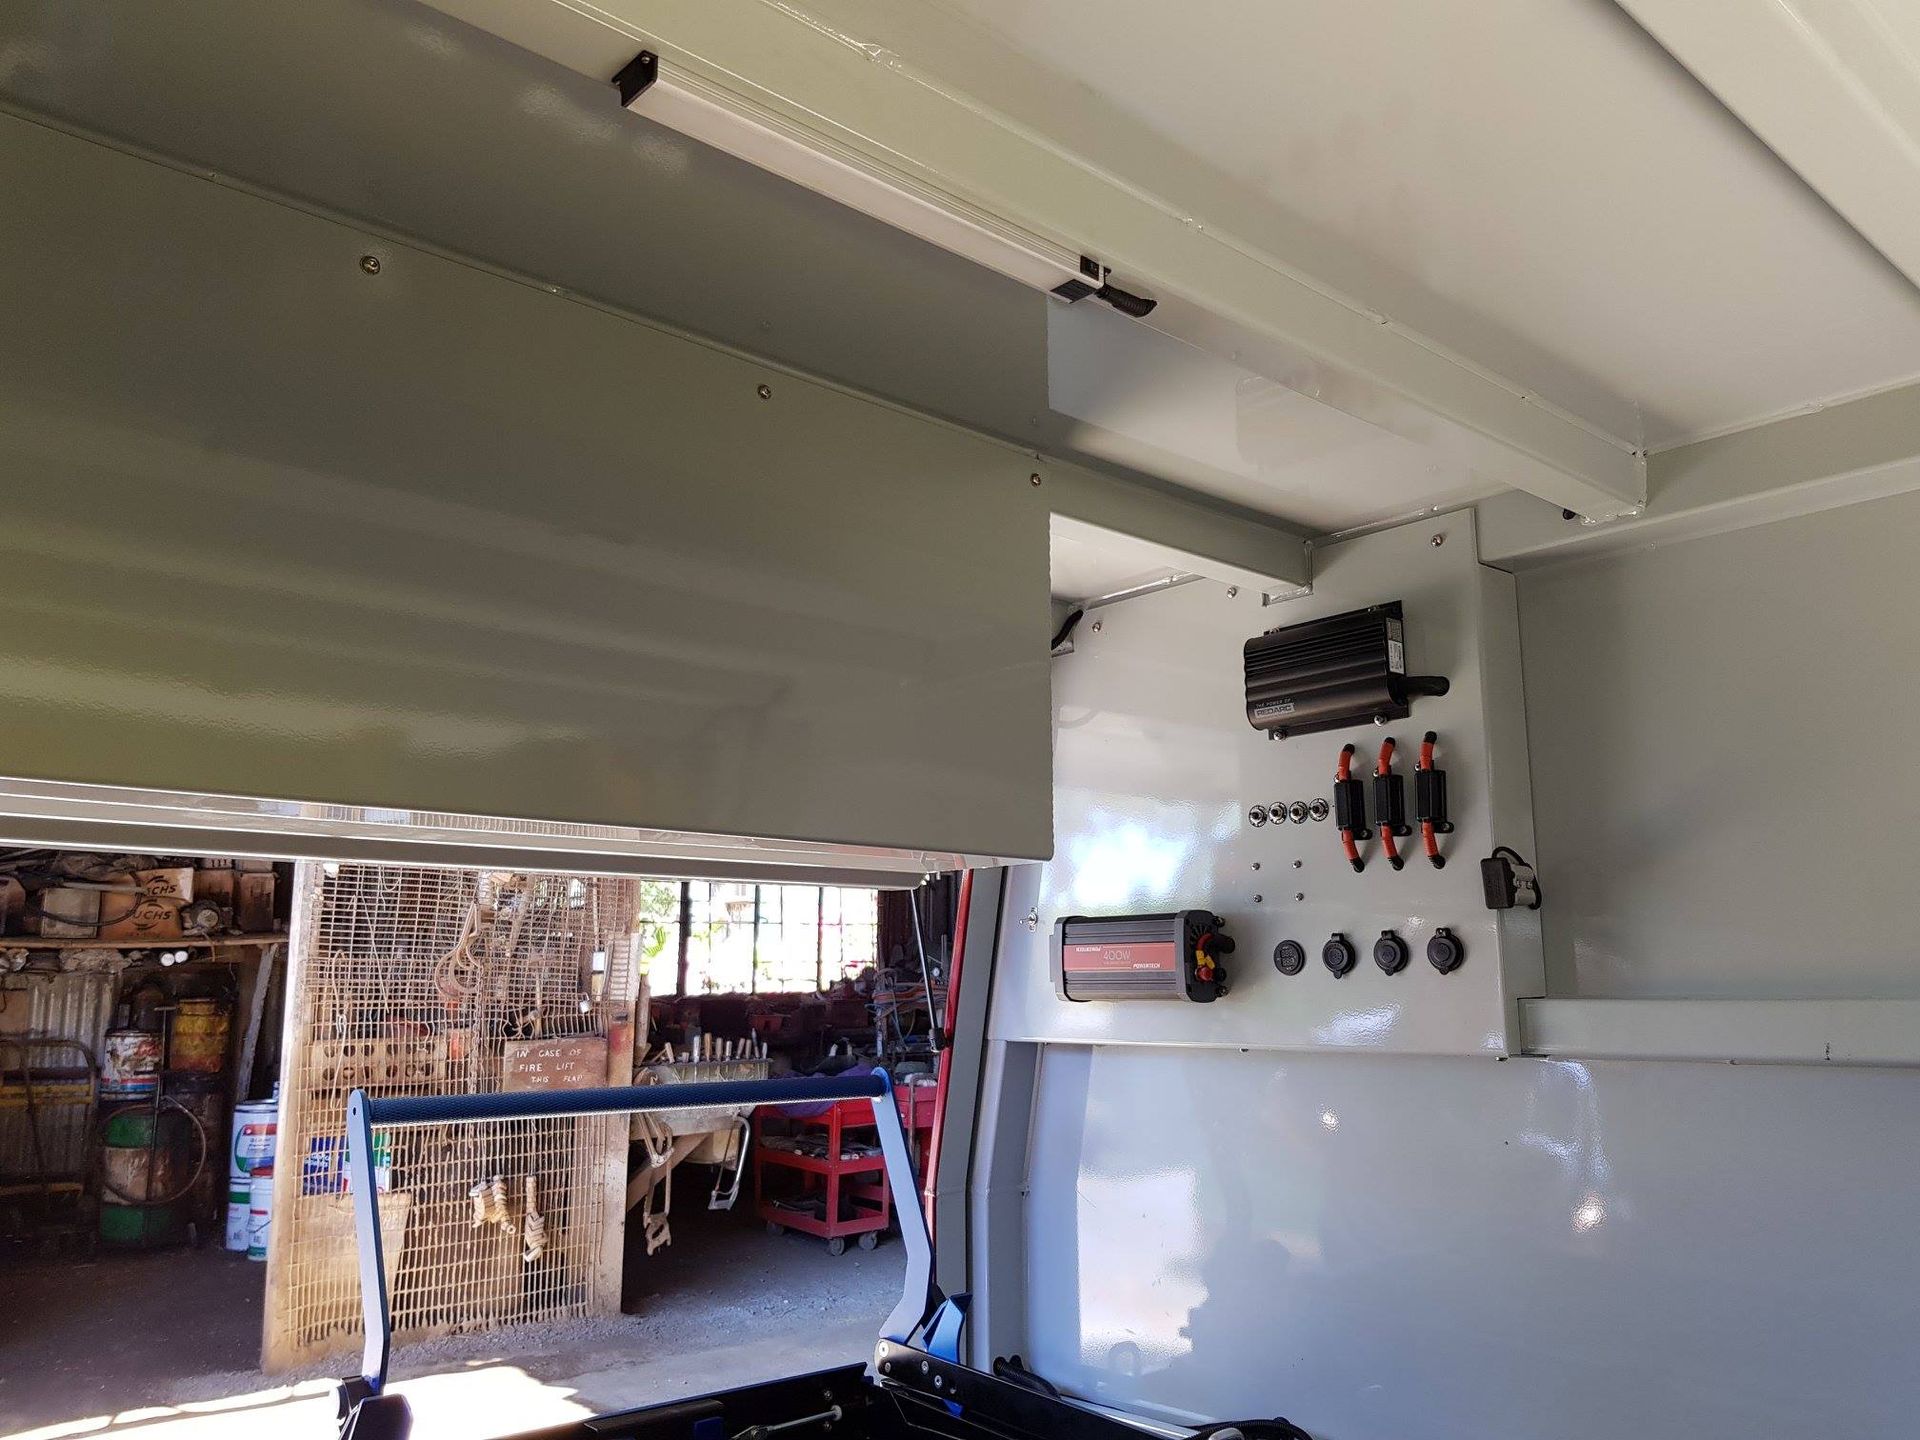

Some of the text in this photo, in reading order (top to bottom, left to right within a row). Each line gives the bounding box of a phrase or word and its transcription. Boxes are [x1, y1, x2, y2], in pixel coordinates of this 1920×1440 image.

[1256, 706, 1292, 716] REDARC
[1103, 950, 1131, 961] 400W
[516, 1048, 582, 1058] IN CASE OF
[519, 1061, 576, 1072] FIRE LIFT
[531, 1075, 550, 1083] THIS
